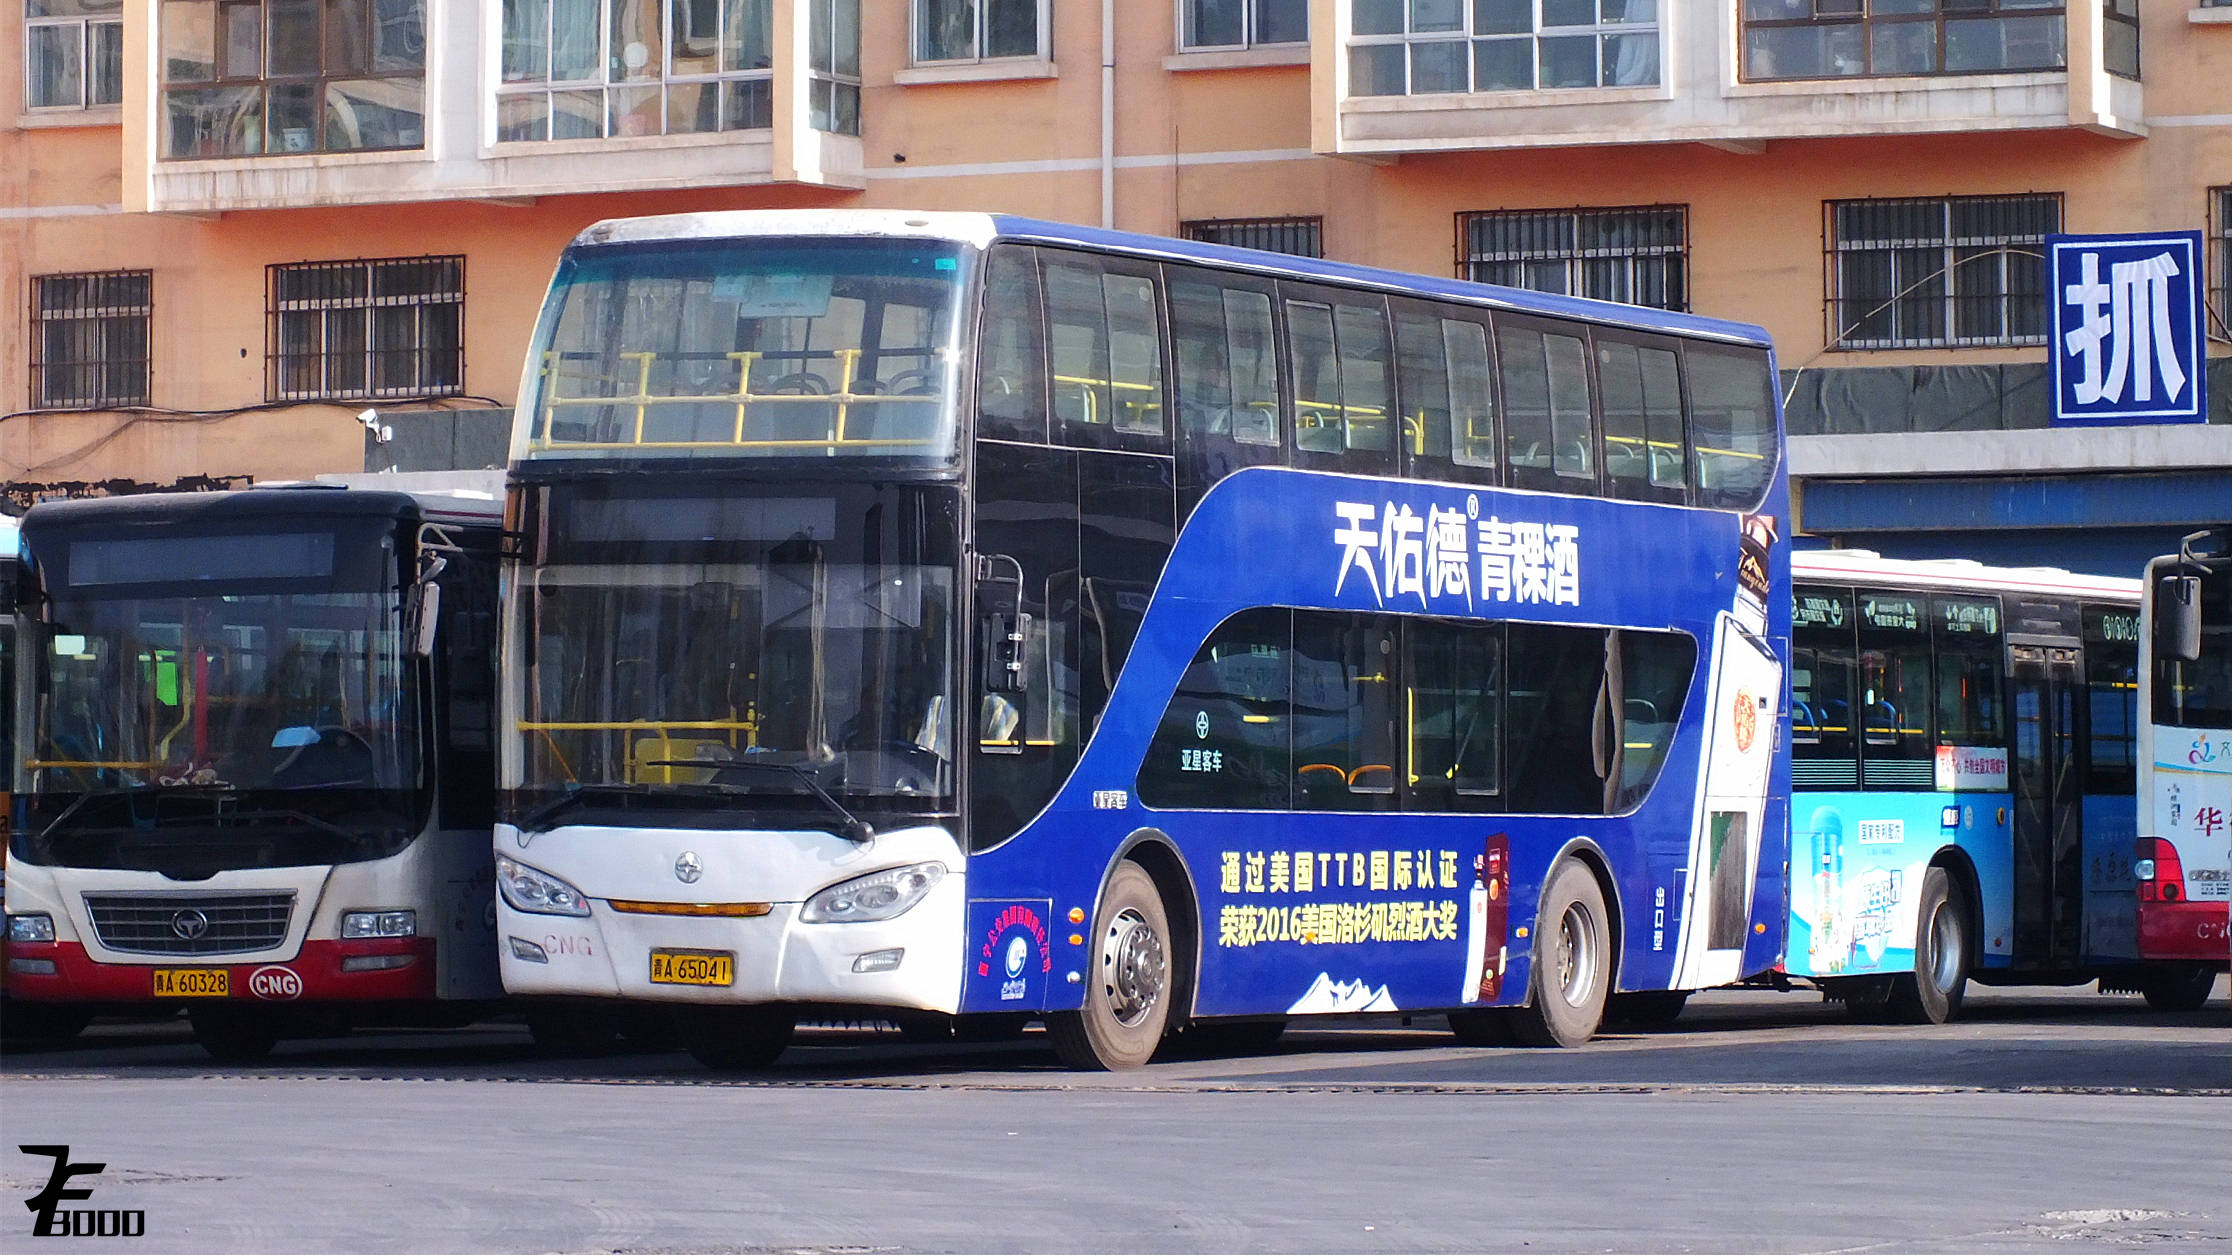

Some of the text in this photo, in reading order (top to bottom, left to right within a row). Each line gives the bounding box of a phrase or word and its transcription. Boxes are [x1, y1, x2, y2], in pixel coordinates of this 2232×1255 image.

[2066, 252, 2186, 404] 抓
[1181, 749, 1222, 773] 亚星客车
[2194, 806, 2232, 838] 华
[1220, 849, 1459, 893] 通过美国TTB国际认证
[1219, 900, 1459, 948] 荣获2016美国洛杉矶烈酒大奖
[255, 975, 296, 995] CNG
